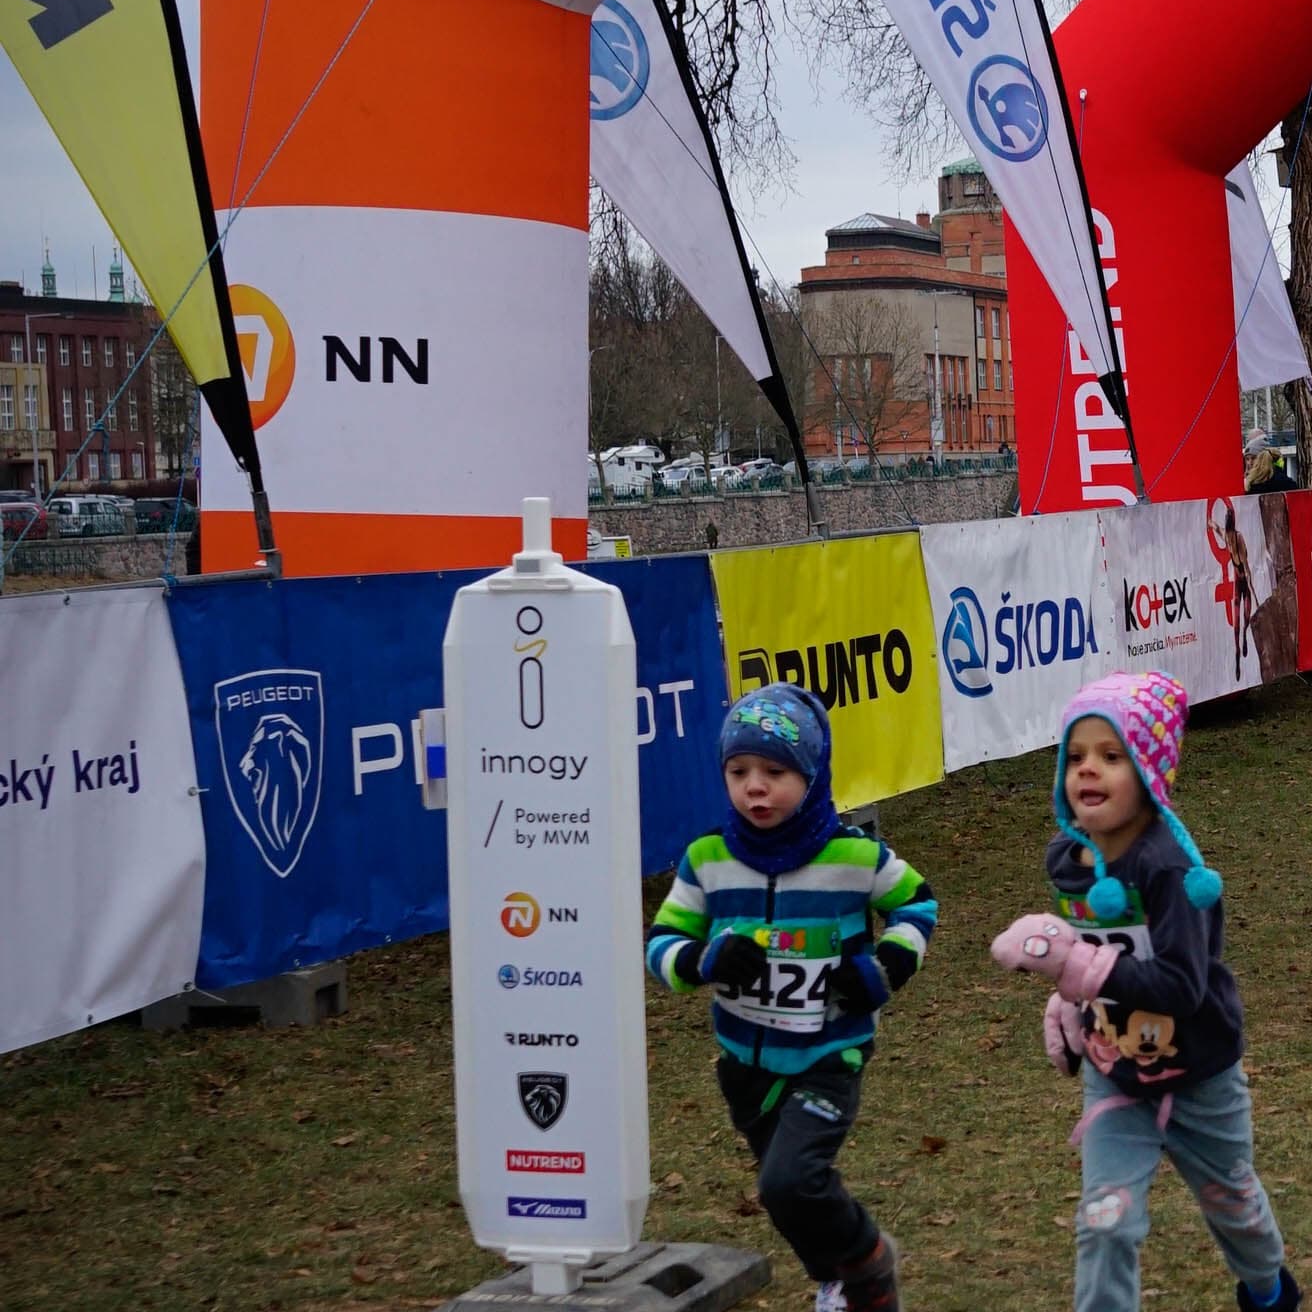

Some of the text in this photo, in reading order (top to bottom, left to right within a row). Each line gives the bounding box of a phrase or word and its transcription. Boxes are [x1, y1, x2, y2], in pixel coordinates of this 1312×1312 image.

[322, 335, 430, 385] NN
[995, 591, 1099, 675] ŠKODA
[227, 686, 314, 712] PEUGEOT
[72, 740, 140, 794] kraj
[481, 747, 588, 780] innogy
[515, 808, 591, 824] Powered
[515, 830, 590, 848] by MVM
[548, 907, 578, 923] NN
[522, 967, 583, 987] ŠKODA
[518, 1033, 579, 1047] RUNTO
[510, 1154, 582, 1170] NUTREND
